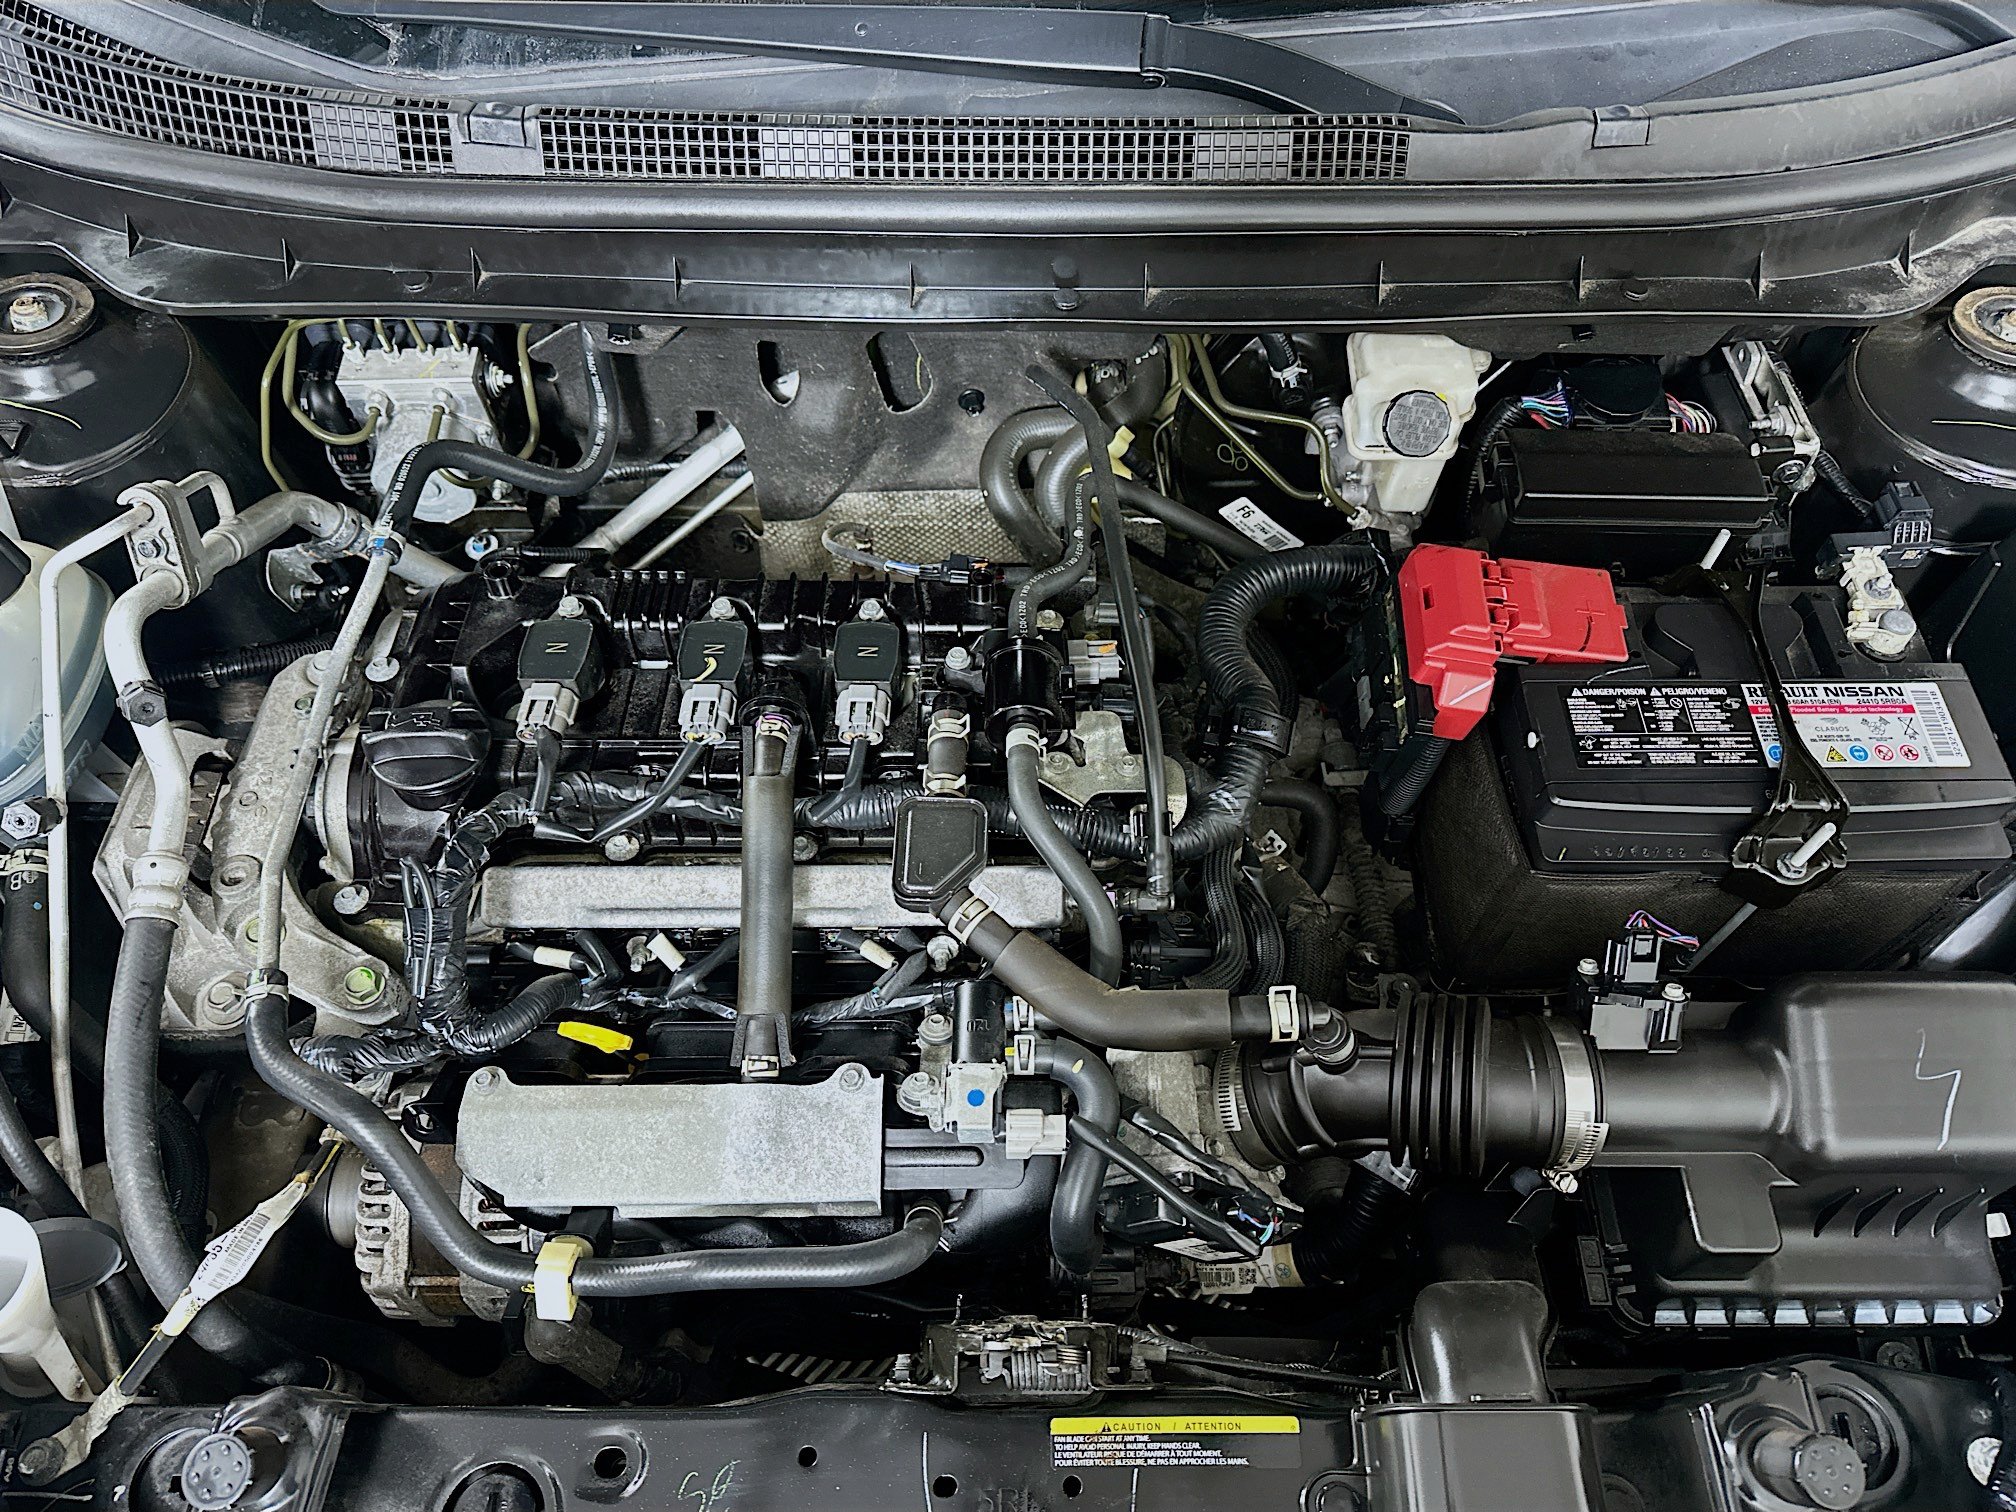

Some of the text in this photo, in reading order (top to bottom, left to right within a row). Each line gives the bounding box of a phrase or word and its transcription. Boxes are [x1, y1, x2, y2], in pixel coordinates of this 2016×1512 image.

[1236, 504, 1255, 519] F6
[1823, 686, 1905, 697] NISSAN
[1113, 1422, 1161, 1431] CAUTION
[1184, 1422, 1242, 1430] ATTENTION
